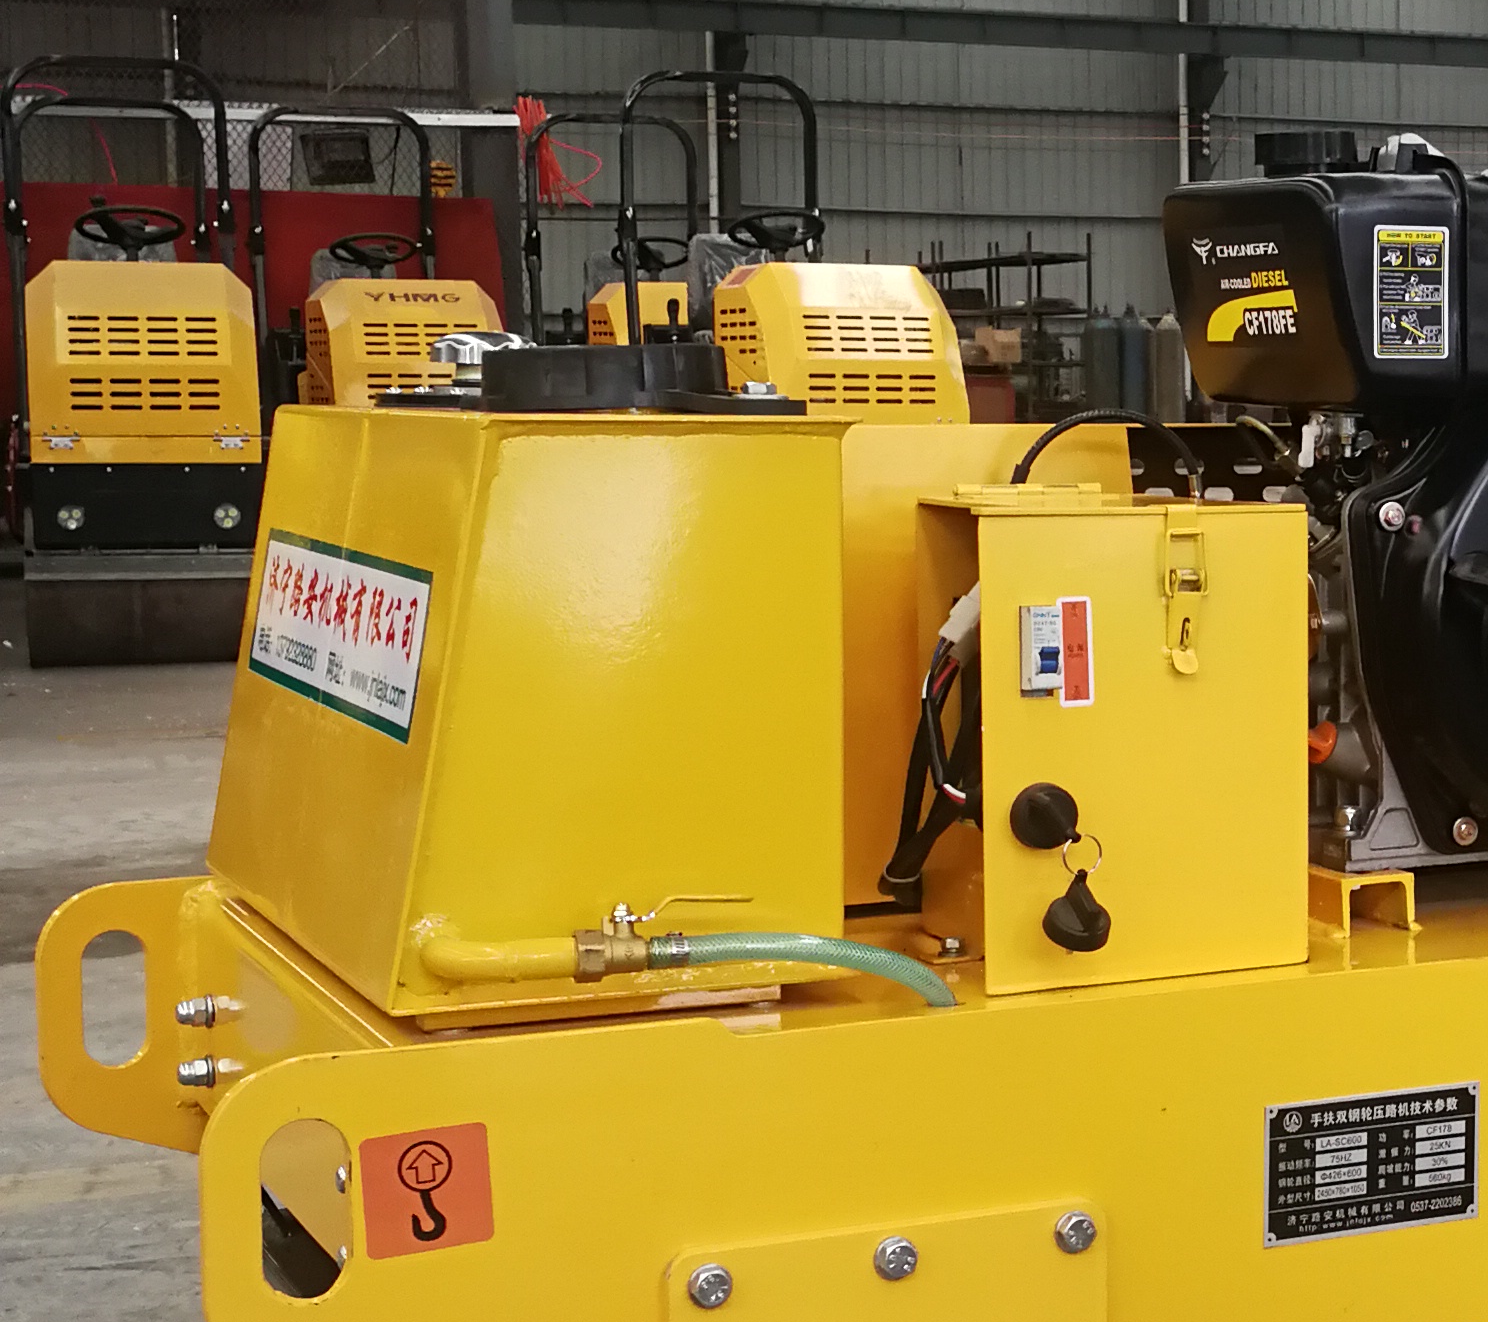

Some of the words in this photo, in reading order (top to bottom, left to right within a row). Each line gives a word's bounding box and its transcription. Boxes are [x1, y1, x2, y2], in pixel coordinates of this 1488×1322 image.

[1215, 241, 1279, 258] CHANGFA
[1250, 268, 1289, 288] DIESEL
[364, 291, 460, 303] YHMG
[1243, 308, 1297, 336] CF178FE
[1310, 1096, 1459, 1128] 手扶双钢轮压路机技术参数
[1426, 1123, 1453, 1135] CF178
[1320, 1135, 1362, 1149] LA-SC600
[1330, 1153, 1353, 1164] 75HZ
[1431, 1157, 1449, 1167] 30%
